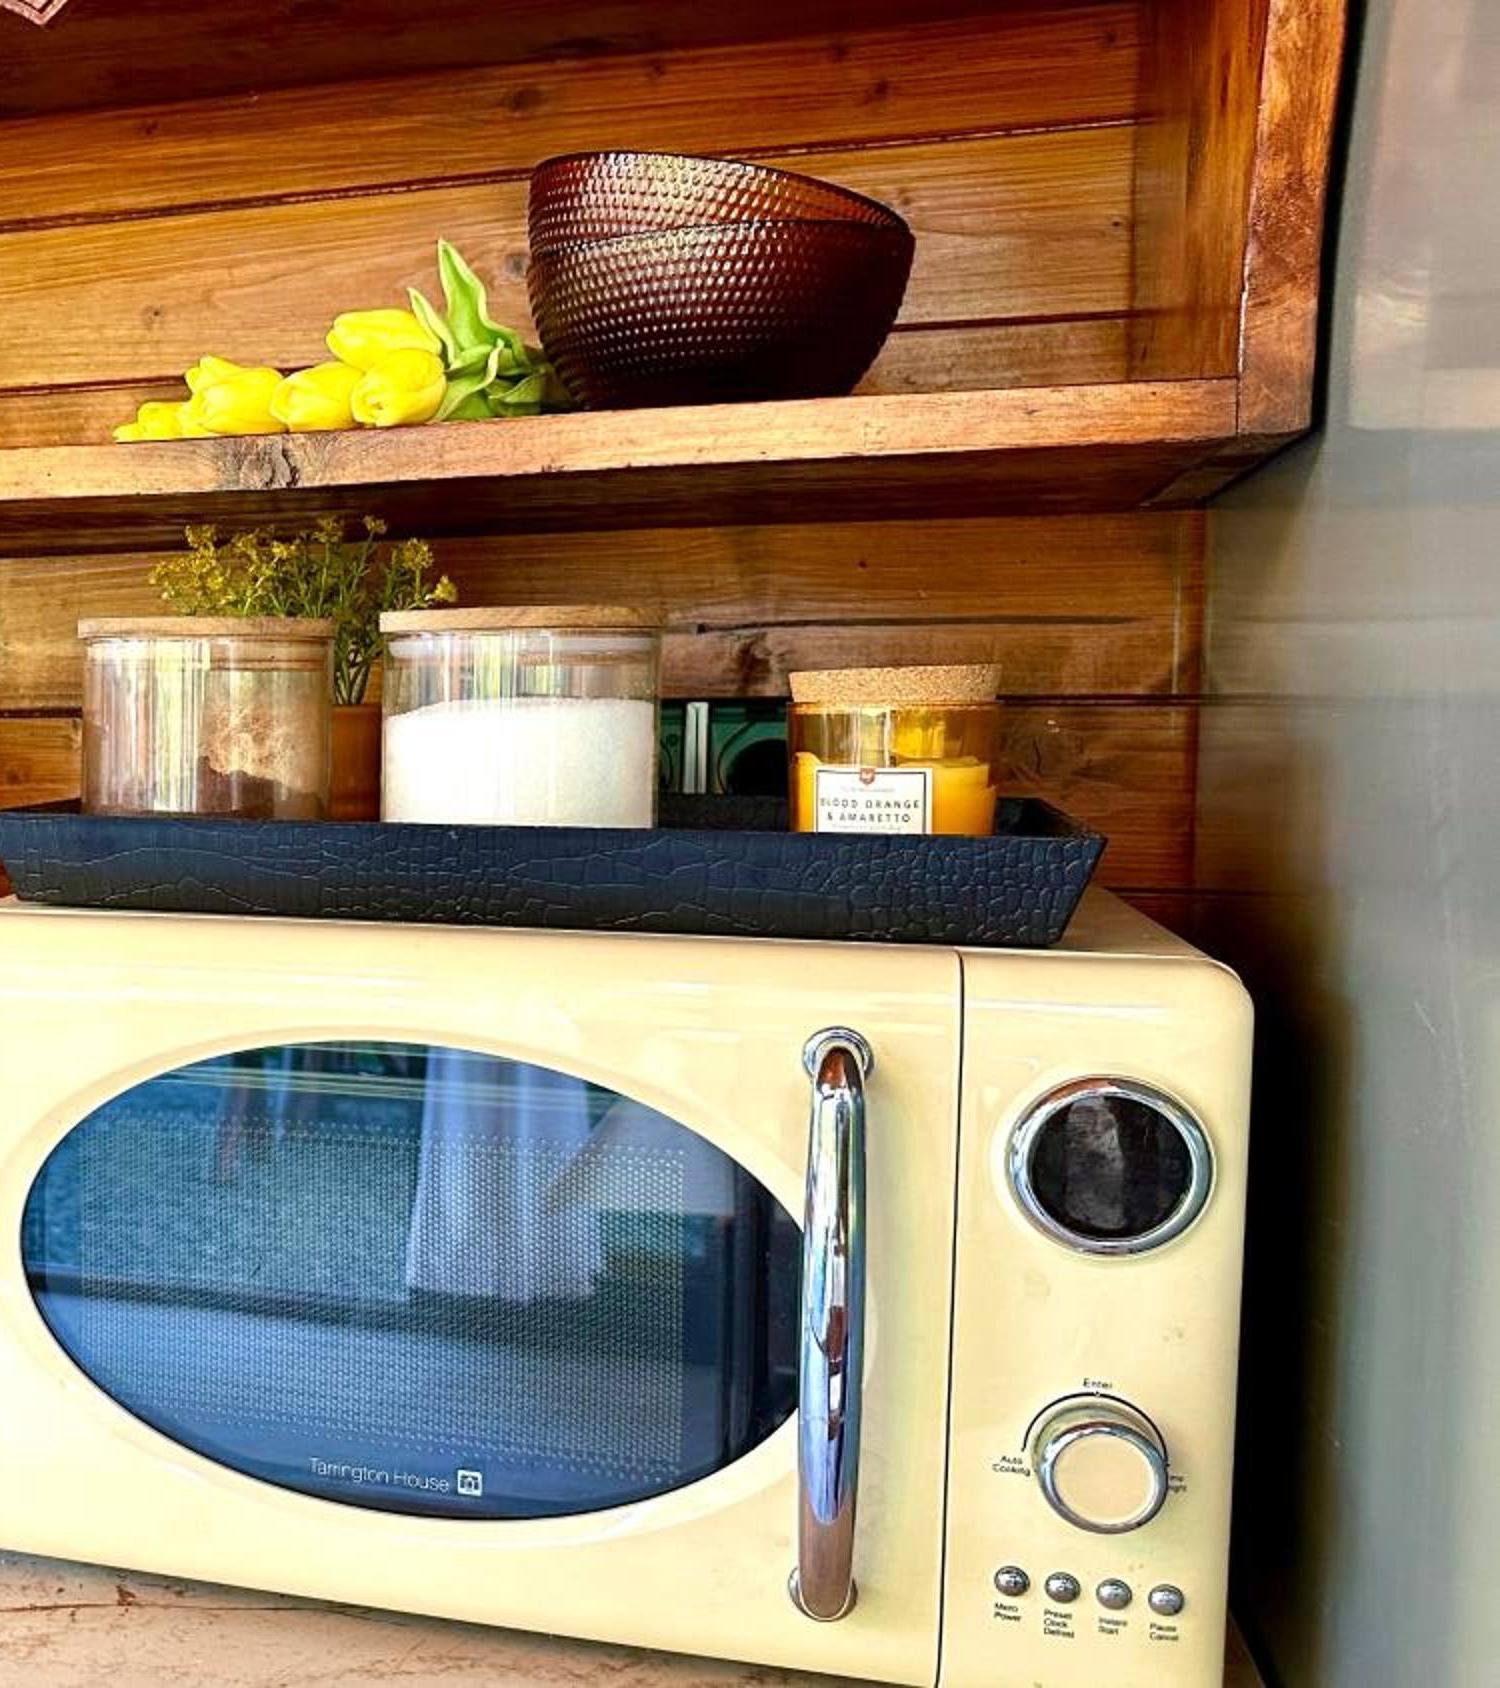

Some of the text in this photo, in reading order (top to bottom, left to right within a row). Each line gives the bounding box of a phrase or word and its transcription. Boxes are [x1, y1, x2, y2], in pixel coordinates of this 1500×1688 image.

[820, 798, 920, 809] BLOOD ORANGE
[839, 813, 911, 823] AMARETTO
[1083, 1377, 1113, 1389] Enter
[1000, 1455, 1023, 1465] Auto
[309, 1457, 450, 1493] Tarrington House
[992, 1463, 1031, 1477] Cooking
